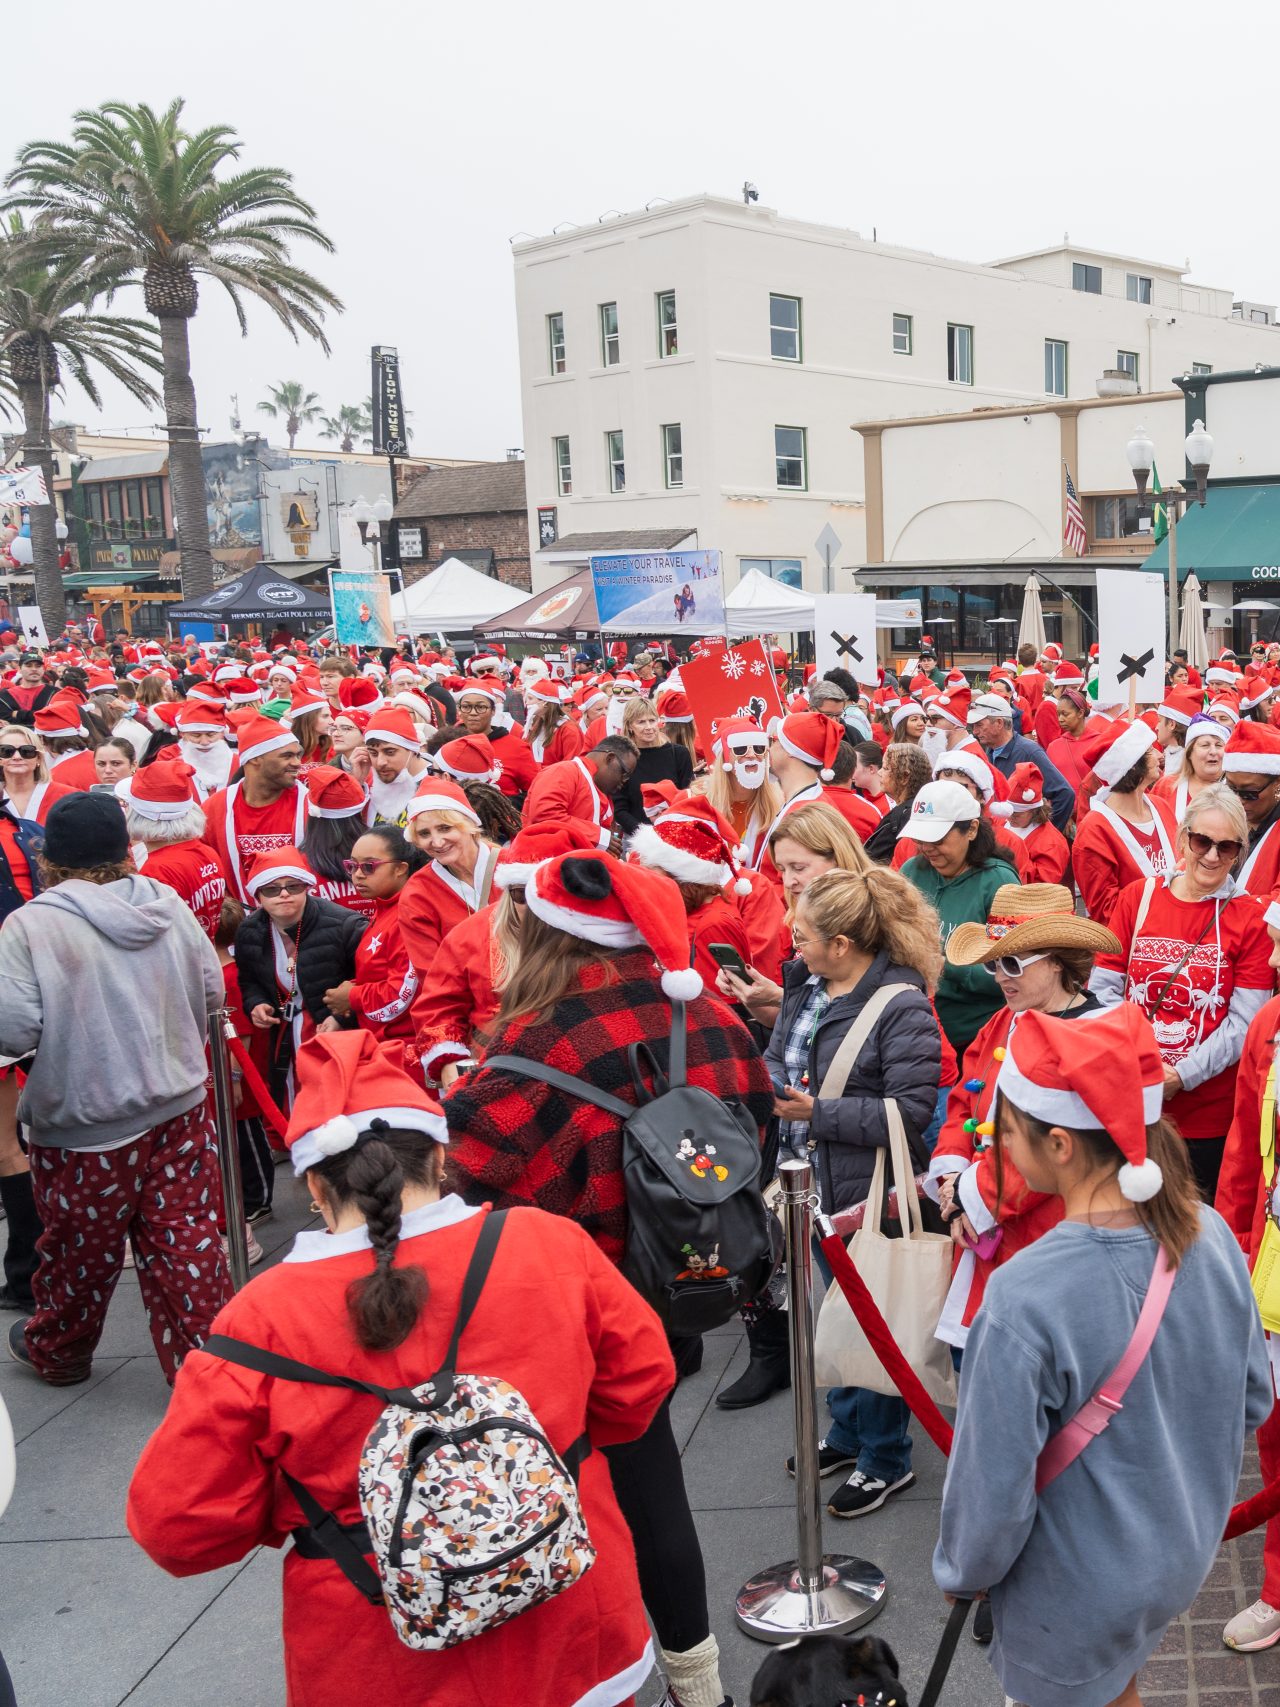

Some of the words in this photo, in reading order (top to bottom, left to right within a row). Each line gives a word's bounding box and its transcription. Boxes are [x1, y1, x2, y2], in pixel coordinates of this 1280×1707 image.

[593, 559, 627, 571] ELEVATE
[630, 559, 652, 569] YOUR
[654, 556, 686, 567] TRAVEL
[595, 577, 610, 585] VISIT
[618, 575, 640, 584] WINTER
[642, 574, 673, 583] PARADISE
[231, 612, 265, 620] HERMOSA
[266, 611, 289, 619] BEACH
[913, 801, 934, 815] USA
